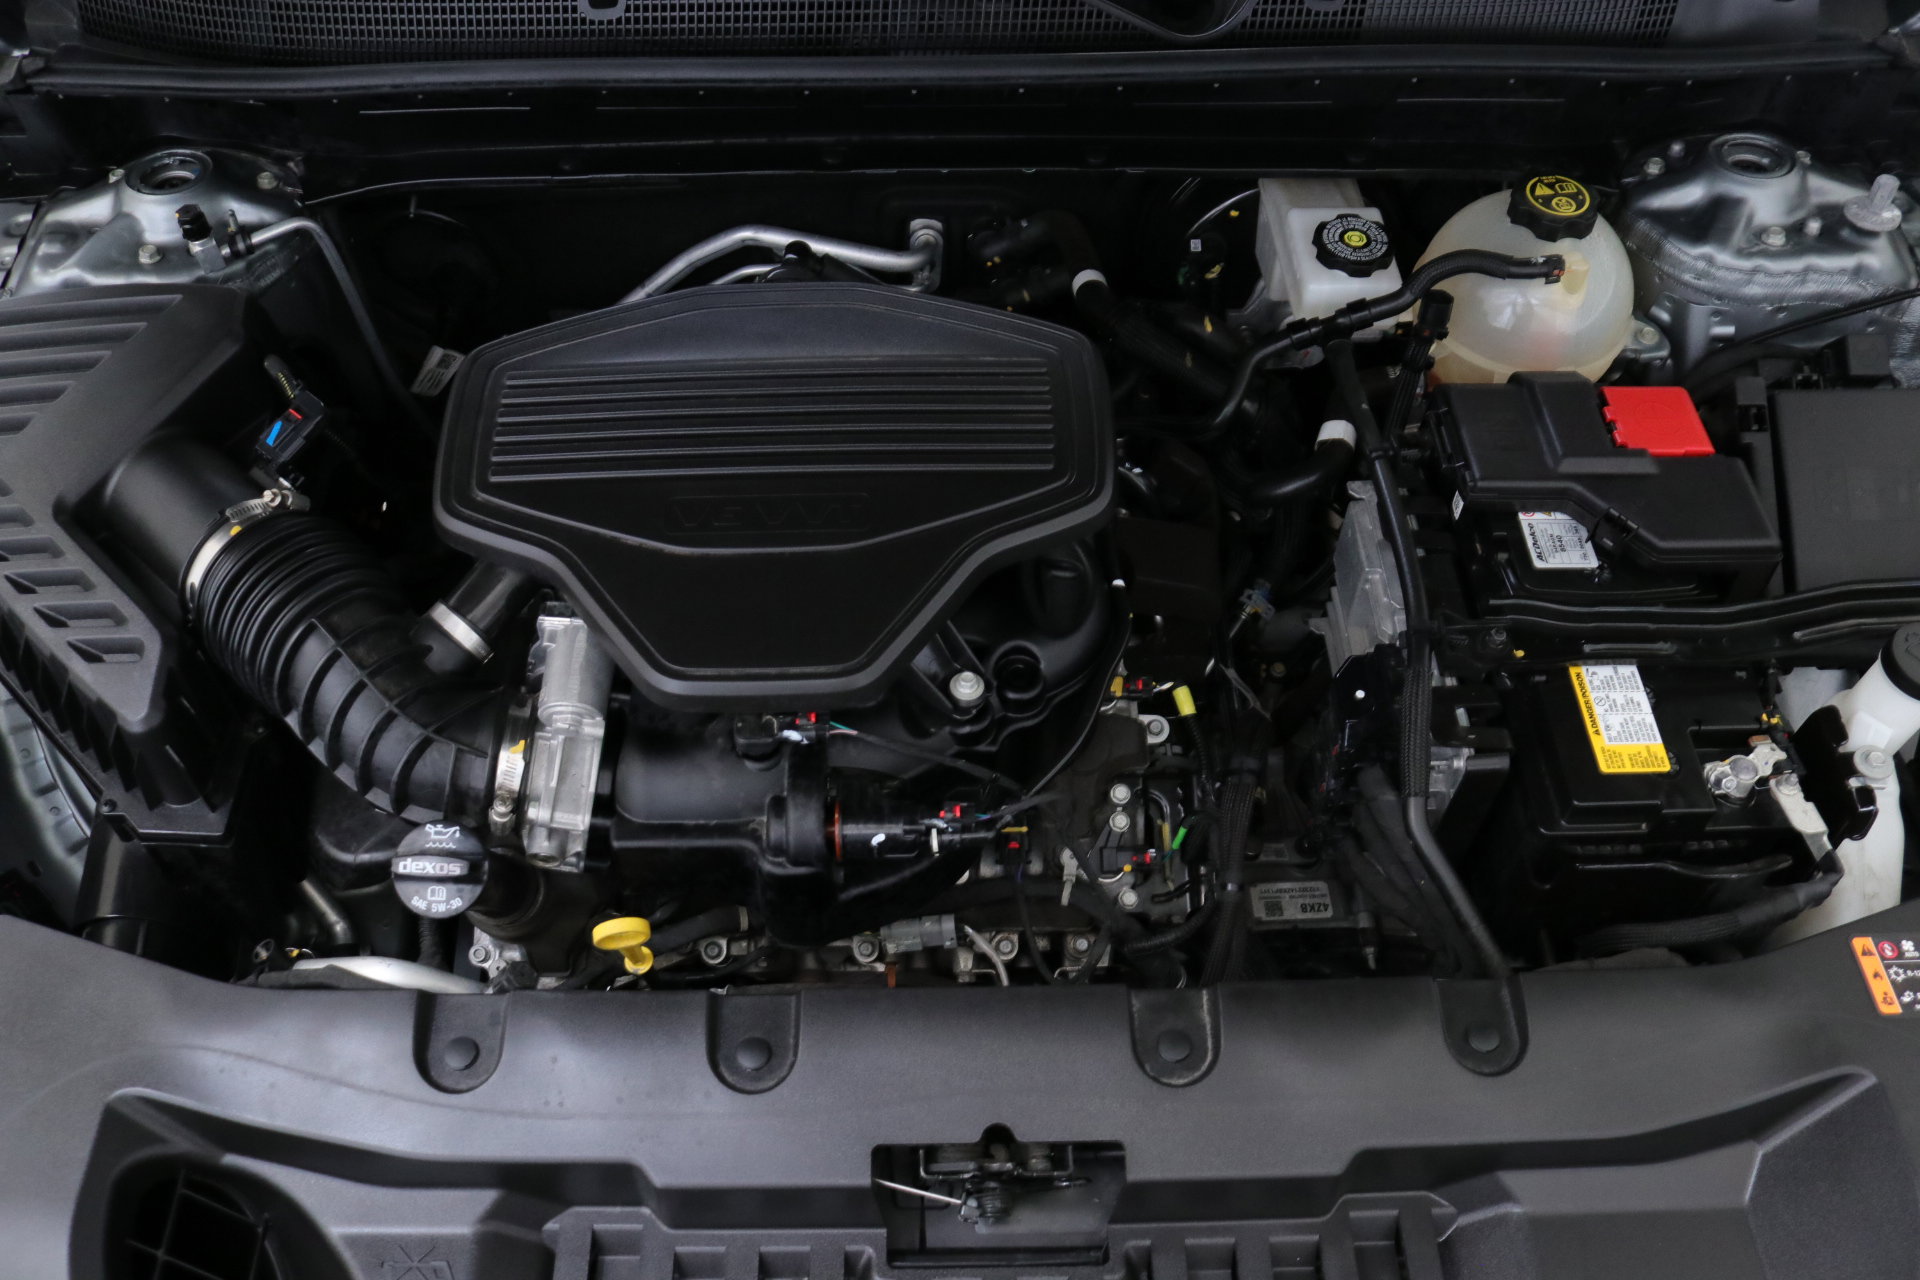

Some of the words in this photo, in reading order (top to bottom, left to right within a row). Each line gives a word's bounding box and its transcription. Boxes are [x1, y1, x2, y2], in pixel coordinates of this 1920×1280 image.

[1528, 523, 1545, 562] ACDelco
[398, 858, 463, 875] dexos
[411, 896, 429, 910] SAE
[431, 897, 463, 913] 5W-30
